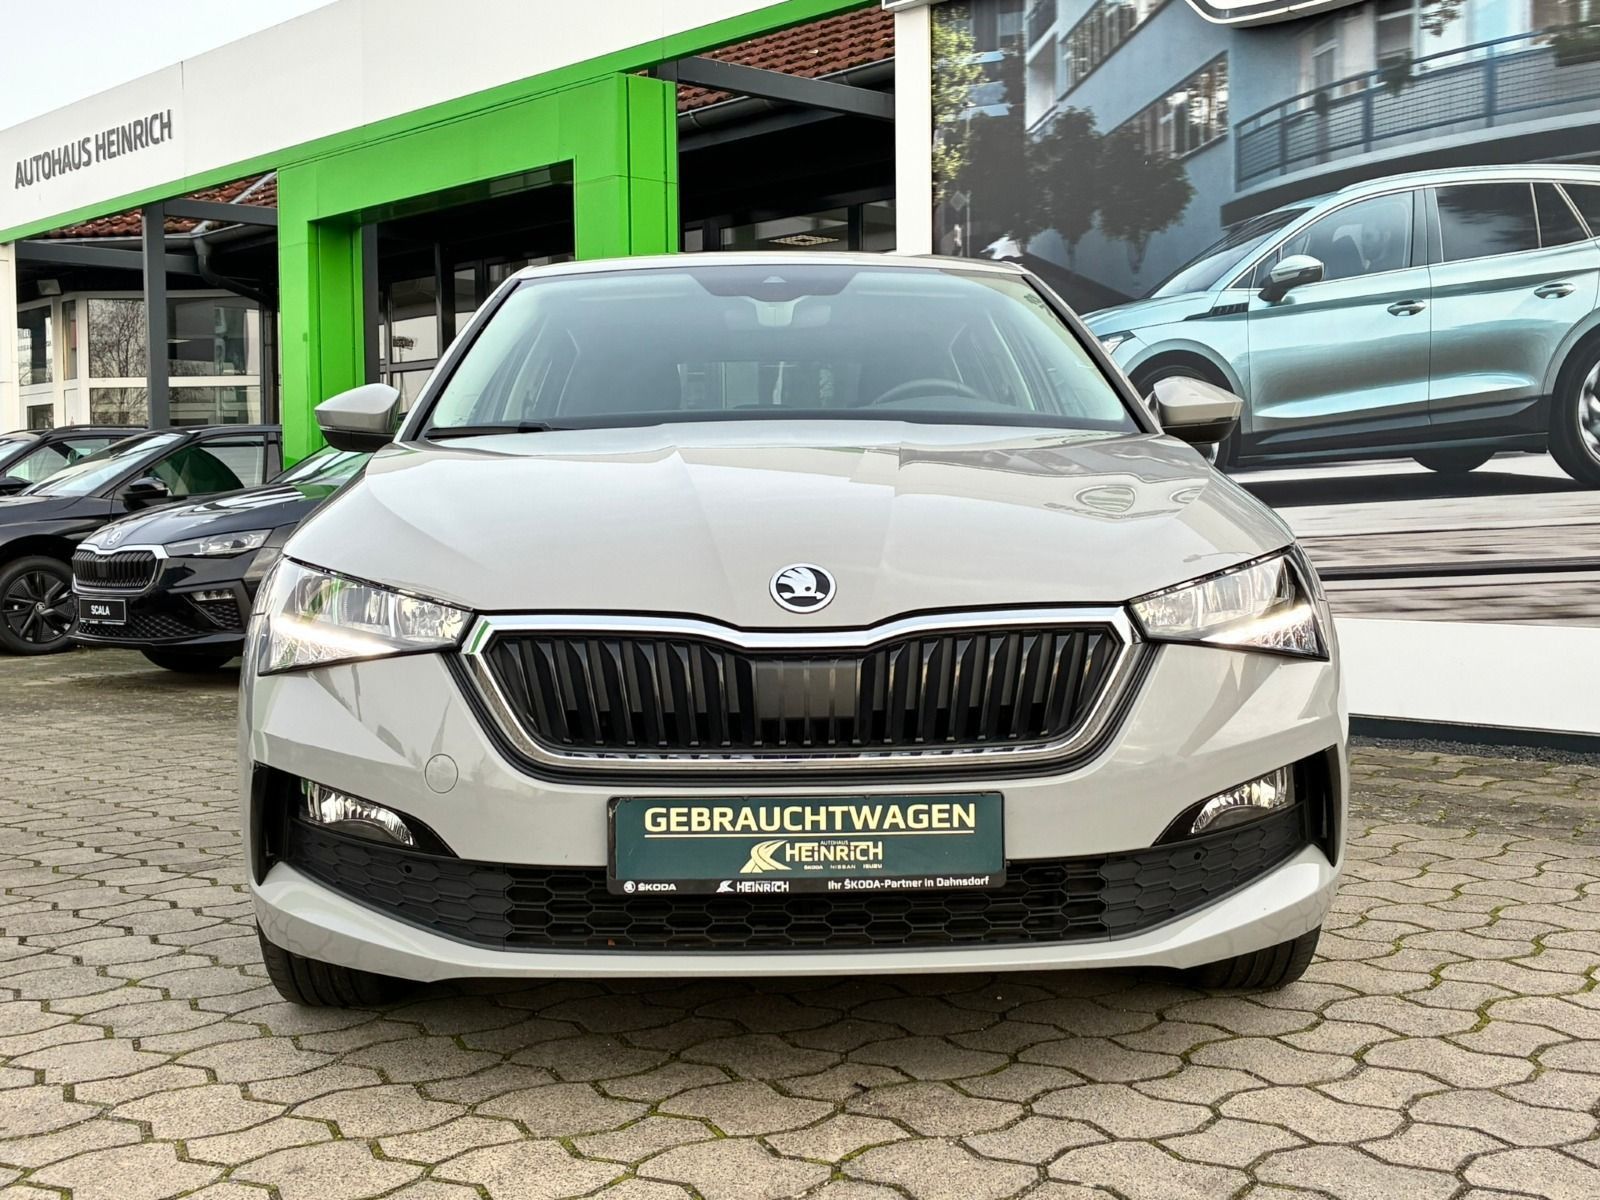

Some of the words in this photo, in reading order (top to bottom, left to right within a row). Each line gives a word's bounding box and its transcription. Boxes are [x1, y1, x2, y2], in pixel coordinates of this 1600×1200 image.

[15, 137, 92, 189] AUTOHAUS
[95, 109, 172, 163] HEINRICH
[91, 605, 110, 616] SCALA
[644, 803, 976, 833] GEBRAUCHTWAGEN
[637, 881, 677, 892] ŠKODA
[827, 880, 842, 890] Ihr
[844, 878, 922, 890] ŠKODA-Partner
[925, 877, 934, 887] in
[936, 875, 990, 887] Dahnsdorf
